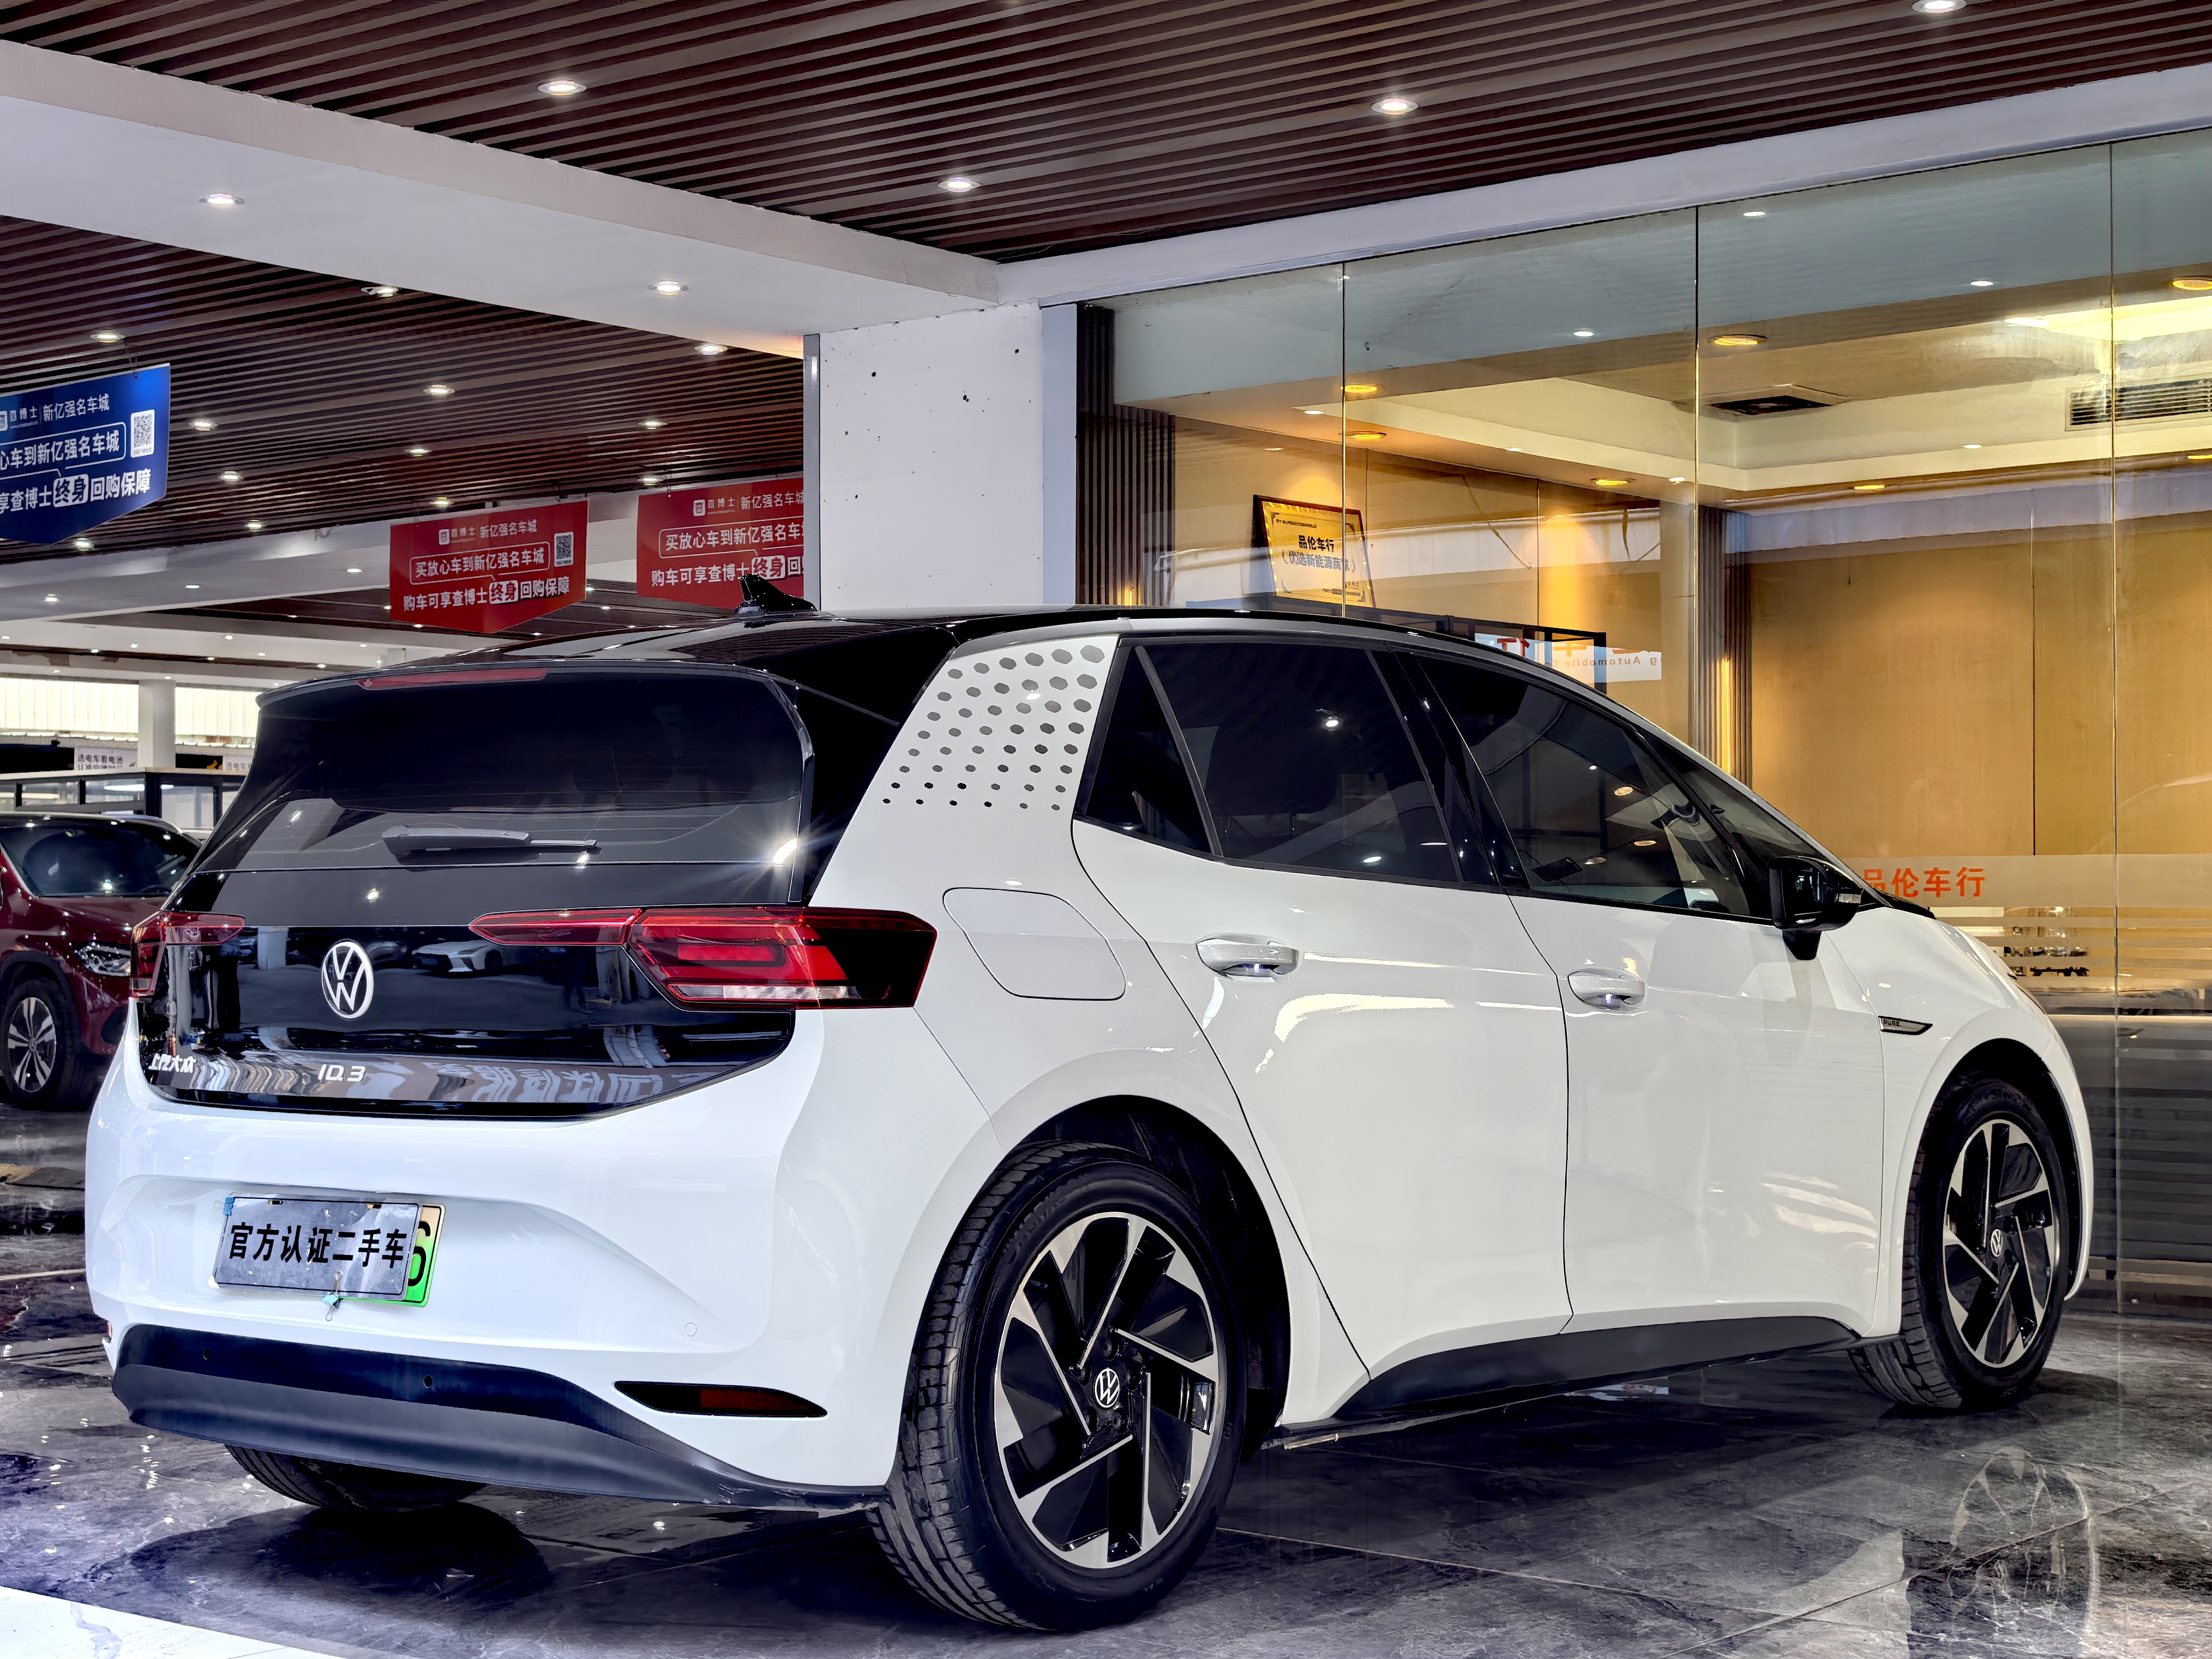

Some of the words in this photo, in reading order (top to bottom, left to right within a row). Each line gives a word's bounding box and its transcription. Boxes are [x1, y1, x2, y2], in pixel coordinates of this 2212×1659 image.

[43, 393, 110, 421] 新亿强名车城
[480, 519, 537, 538] 新亿强名车城
[666, 522, 804, 551] 买放心车到新亿强名车
[1298, 535, 1334, 552] 品伦车行
[415, 547, 544, 578] 买放心车到新亿强名车城
[651, 556, 804, 586] 购车可享查博士终身回
[403, 576, 570, 611] 购车可享查博士终身回购保障
[1864, 866, 1985, 898] 品伦车行
[149, 1053, 197, 1073] 上汽大众
[229, 1222, 407, 1269] 官方认证二手车
